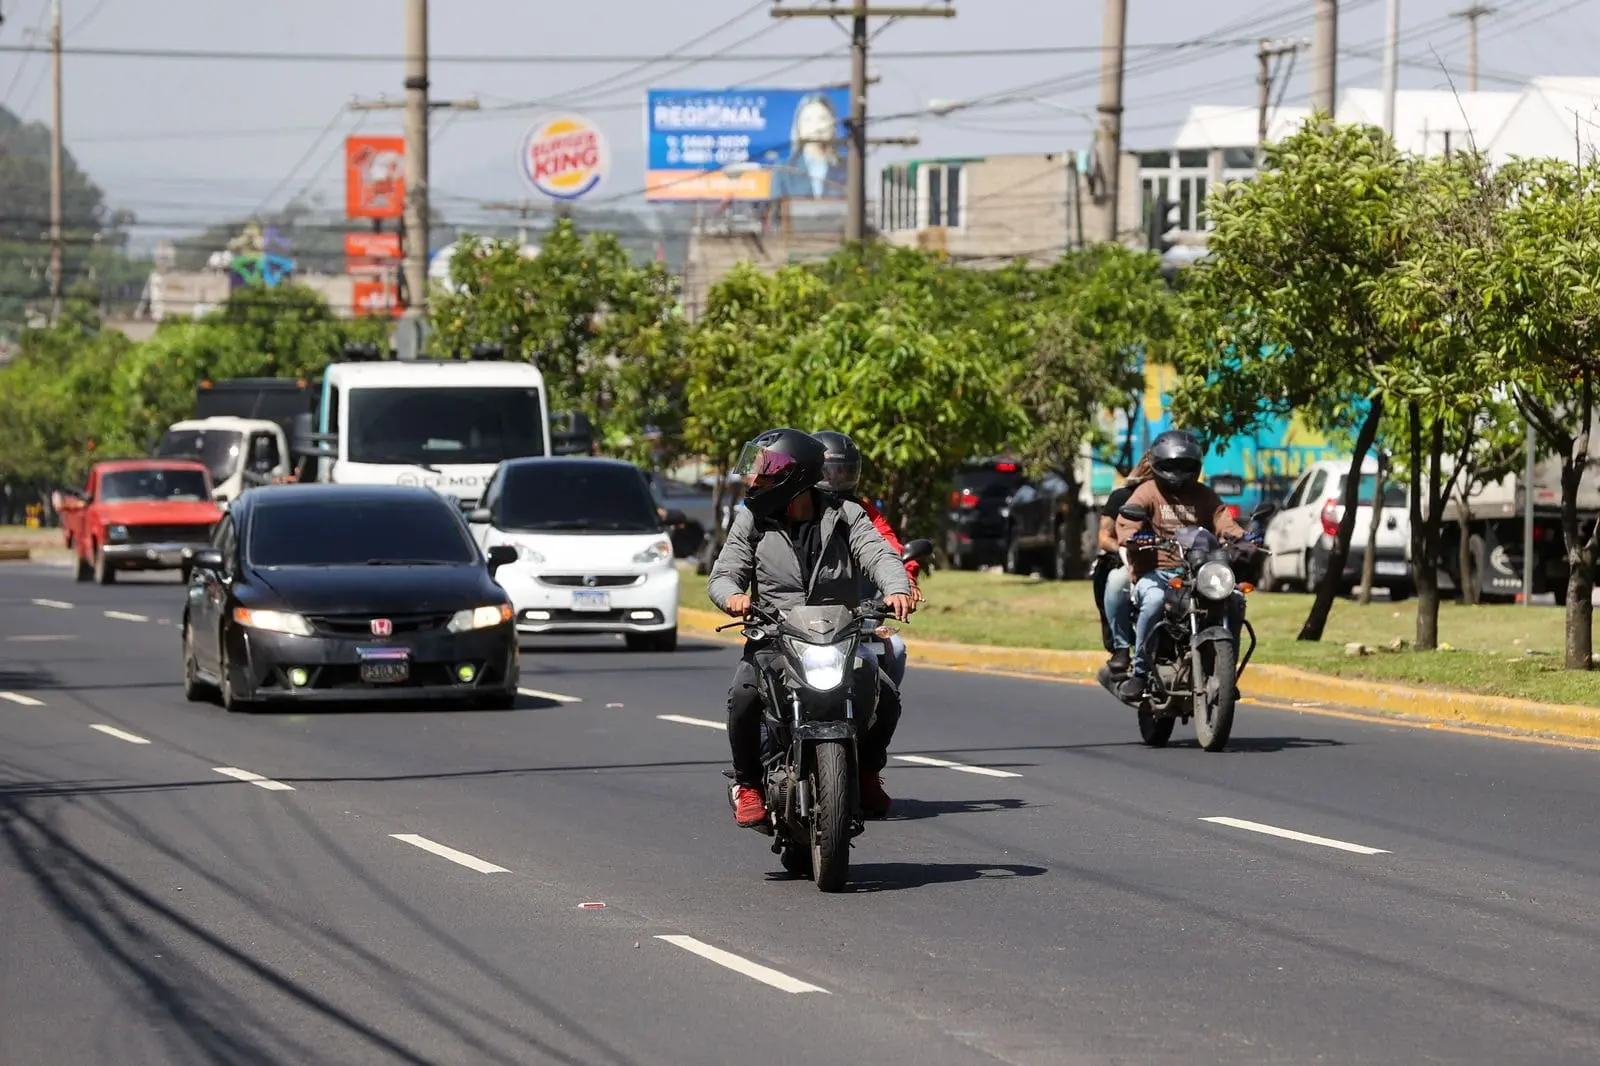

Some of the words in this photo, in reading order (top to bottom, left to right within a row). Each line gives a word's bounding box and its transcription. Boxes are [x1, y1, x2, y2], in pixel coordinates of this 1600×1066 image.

[654, 105, 767, 128] REGIONAL
[531, 132, 596, 157] BURGER
[534, 147, 598, 180] KING
